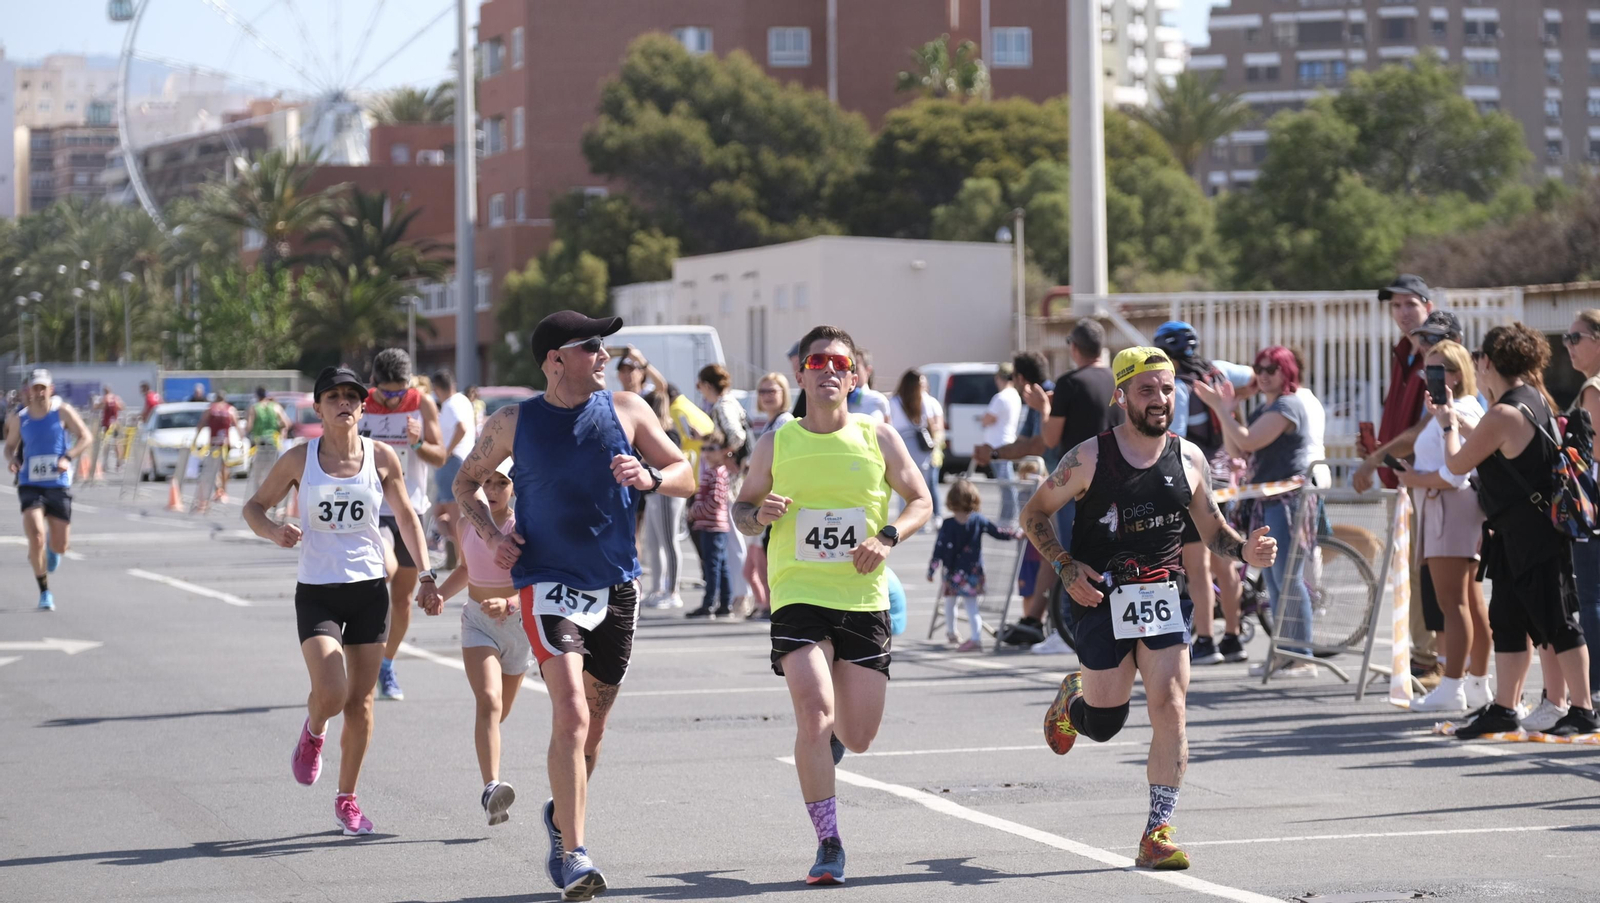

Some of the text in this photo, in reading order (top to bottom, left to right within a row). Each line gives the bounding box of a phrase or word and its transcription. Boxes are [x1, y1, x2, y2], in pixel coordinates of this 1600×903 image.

[318, 500, 364, 522] 376
[1122, 502, 1155, 522] pies
[805, 525, 857, 550] 454
[545, 583, 598, 615] 457
[1122, 599, 1172, 625] 456
